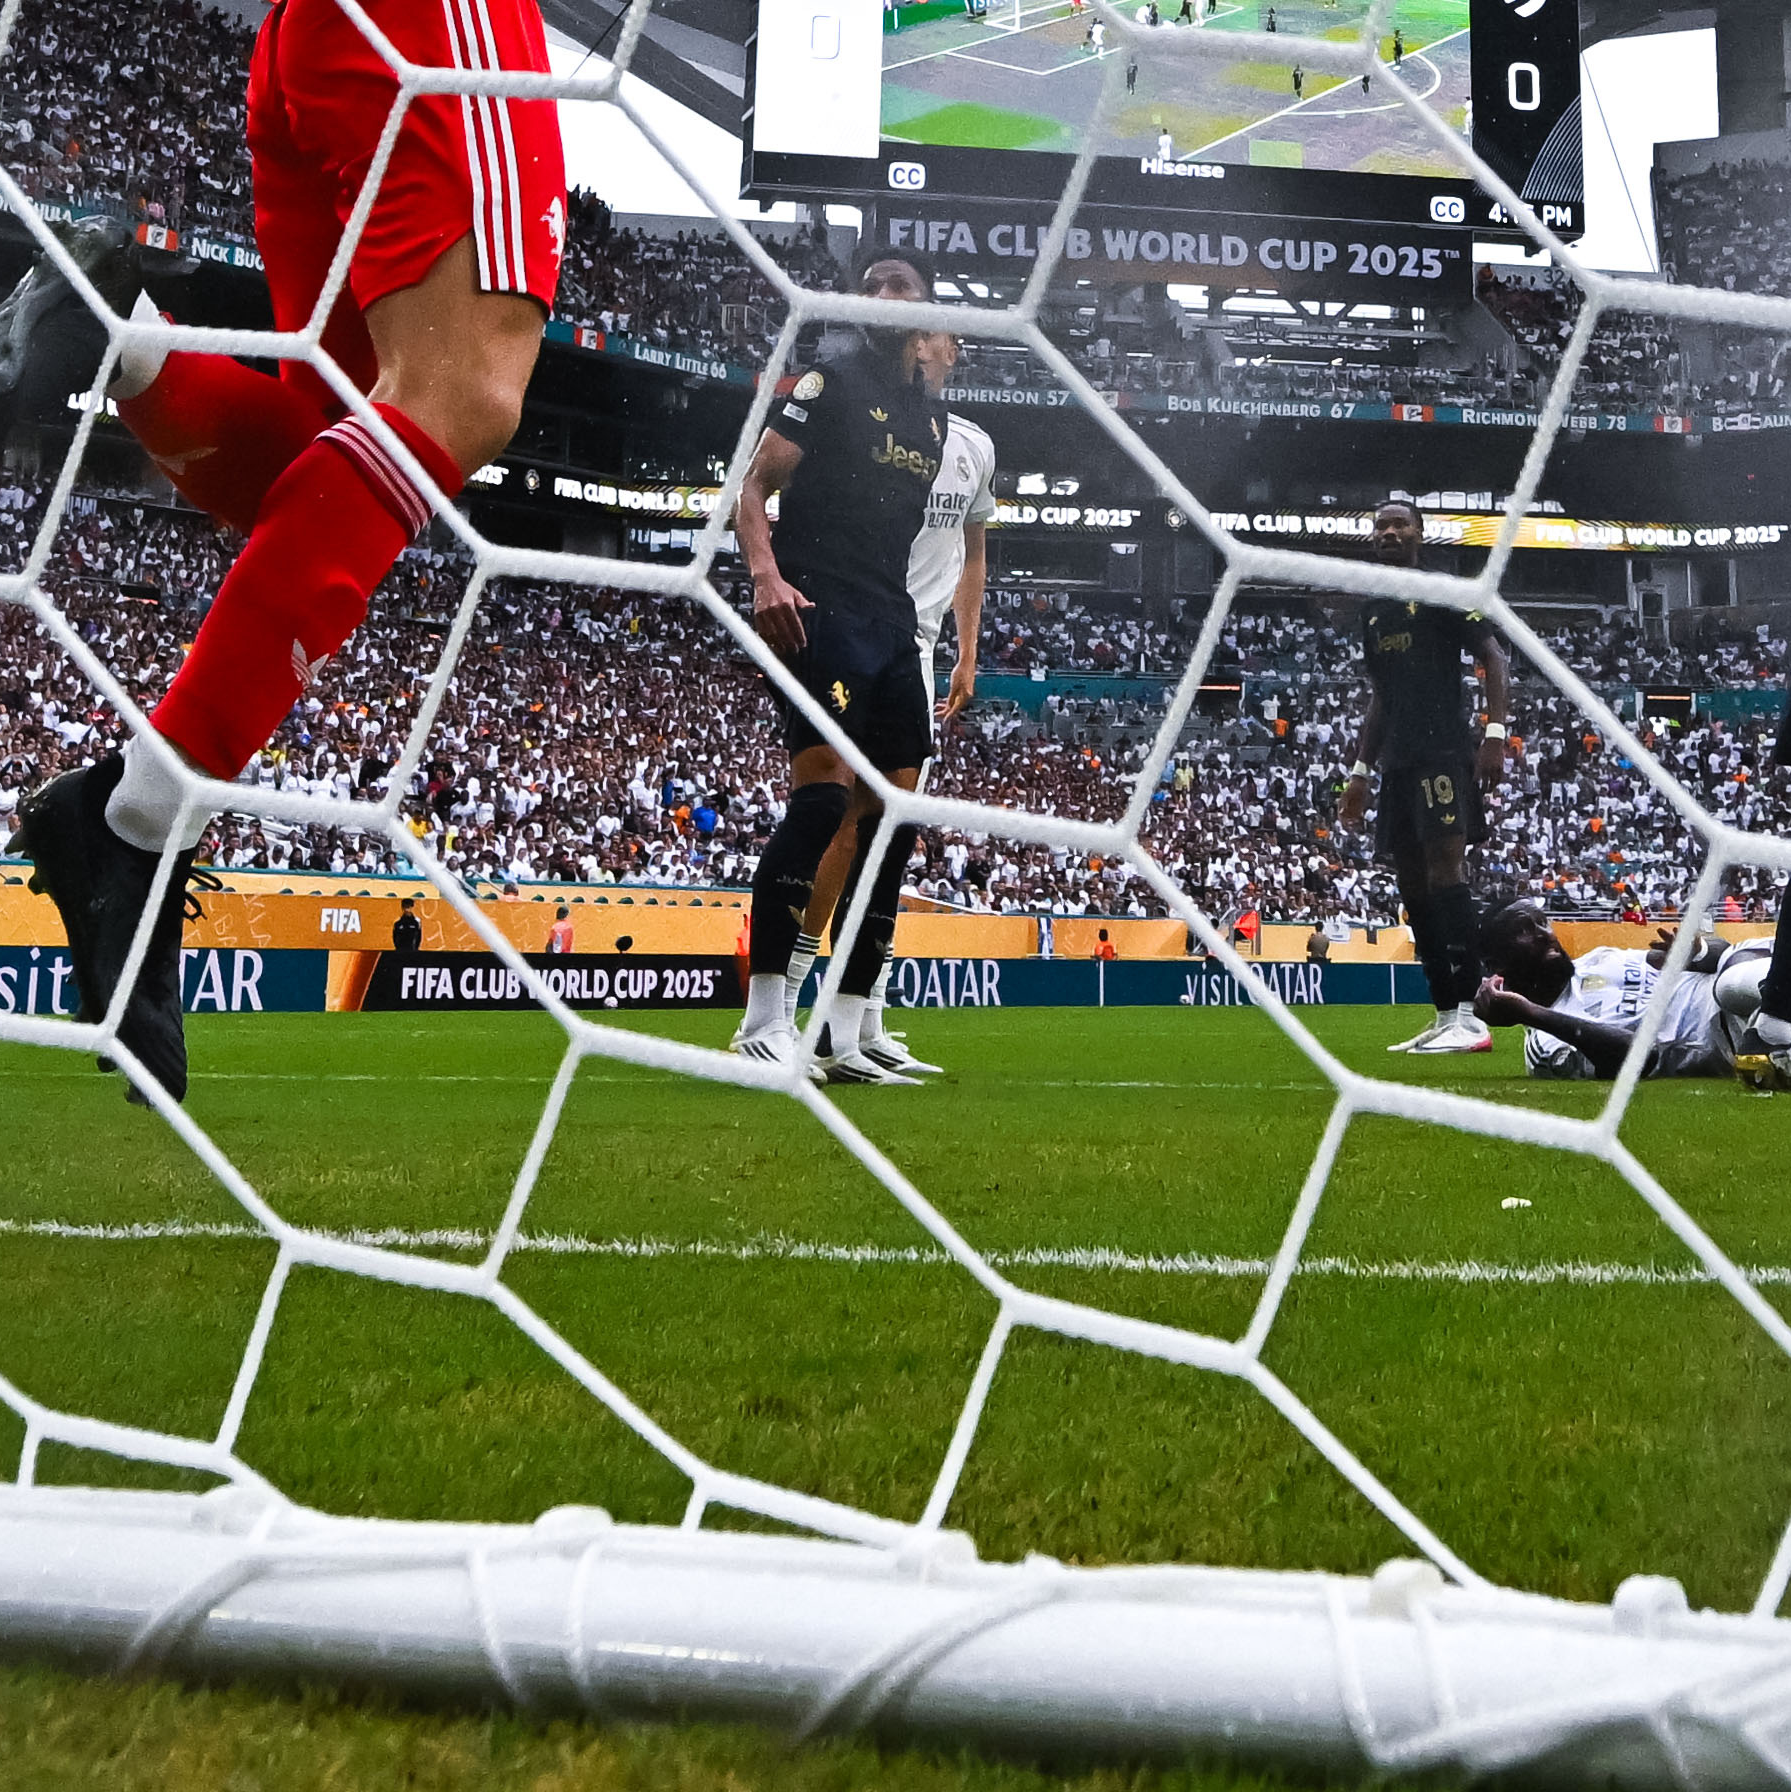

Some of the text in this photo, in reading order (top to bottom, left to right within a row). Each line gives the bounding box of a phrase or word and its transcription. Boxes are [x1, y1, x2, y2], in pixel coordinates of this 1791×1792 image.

[1507, 61, 1541, 112] 0
[892, 167, 922, 185] CC
[1140, 157, 1226, 180] Hisense
[1434, 201, 1461, 220] CC
[1542, 204, 1573, 228] PM
[190, 236, 229, 264] NICK
[889, 217, 979, 255] FIFA
[1101, 227, 1250, 267] WORLD
[1258, 237, 1338, 272] CUP
[633, 342, 728, 381] LARRY LITTLE 66
[939, 387, 1071, 407] TEPHENSON 57
[1167, 394, 1357, 419] BOB KUECHENBERG 67
[1606, 414, 1627, 431] 78
[870, 432, 938, 482] Jeep
[553, 476, 583, 502] FIFA
[583, 483, 618, 506] CLUB
[619, 489, 684, 513] WORLD
[986, 504, 1134, 528] RLD CUP 2025
[1210, 512, 1251, 532] FIFA
[1252, 513, 1302, 534] CLUB
[1304, 515, 1375, 536] WORLD
[1535, 522, 1781, 547] FIFA CLUB WORLD CUP 2025
[319, 907, 362, 935] FIFA
[400, 967, 455, 1000] FIFA
[459, 967, 522, 1000] CLUB
[613, 969, 658, 1000] CUP
